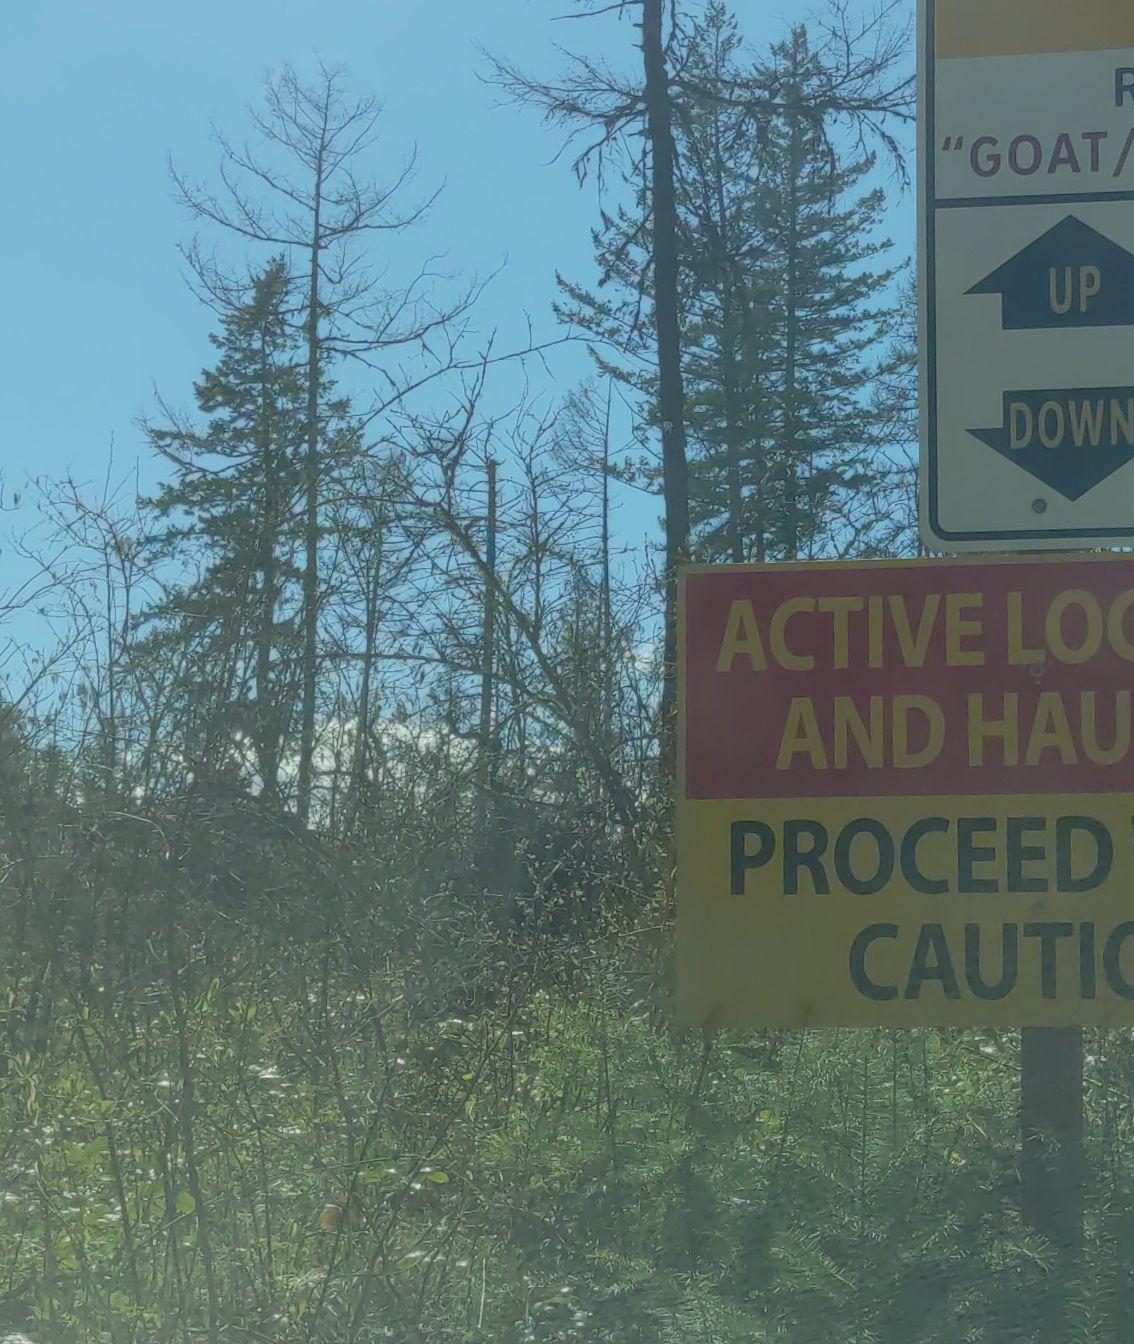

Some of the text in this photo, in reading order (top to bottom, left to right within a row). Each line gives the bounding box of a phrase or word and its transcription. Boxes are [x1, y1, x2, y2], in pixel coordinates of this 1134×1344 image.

[1048, 265, 1101, 315] UP
[1009, 398, 1134, 449] DOWN
[716, 592, 985, 672] ACTIVE
[775, 695, 945, 770] AND
[730, 815, 1113, 896] PROCEED
